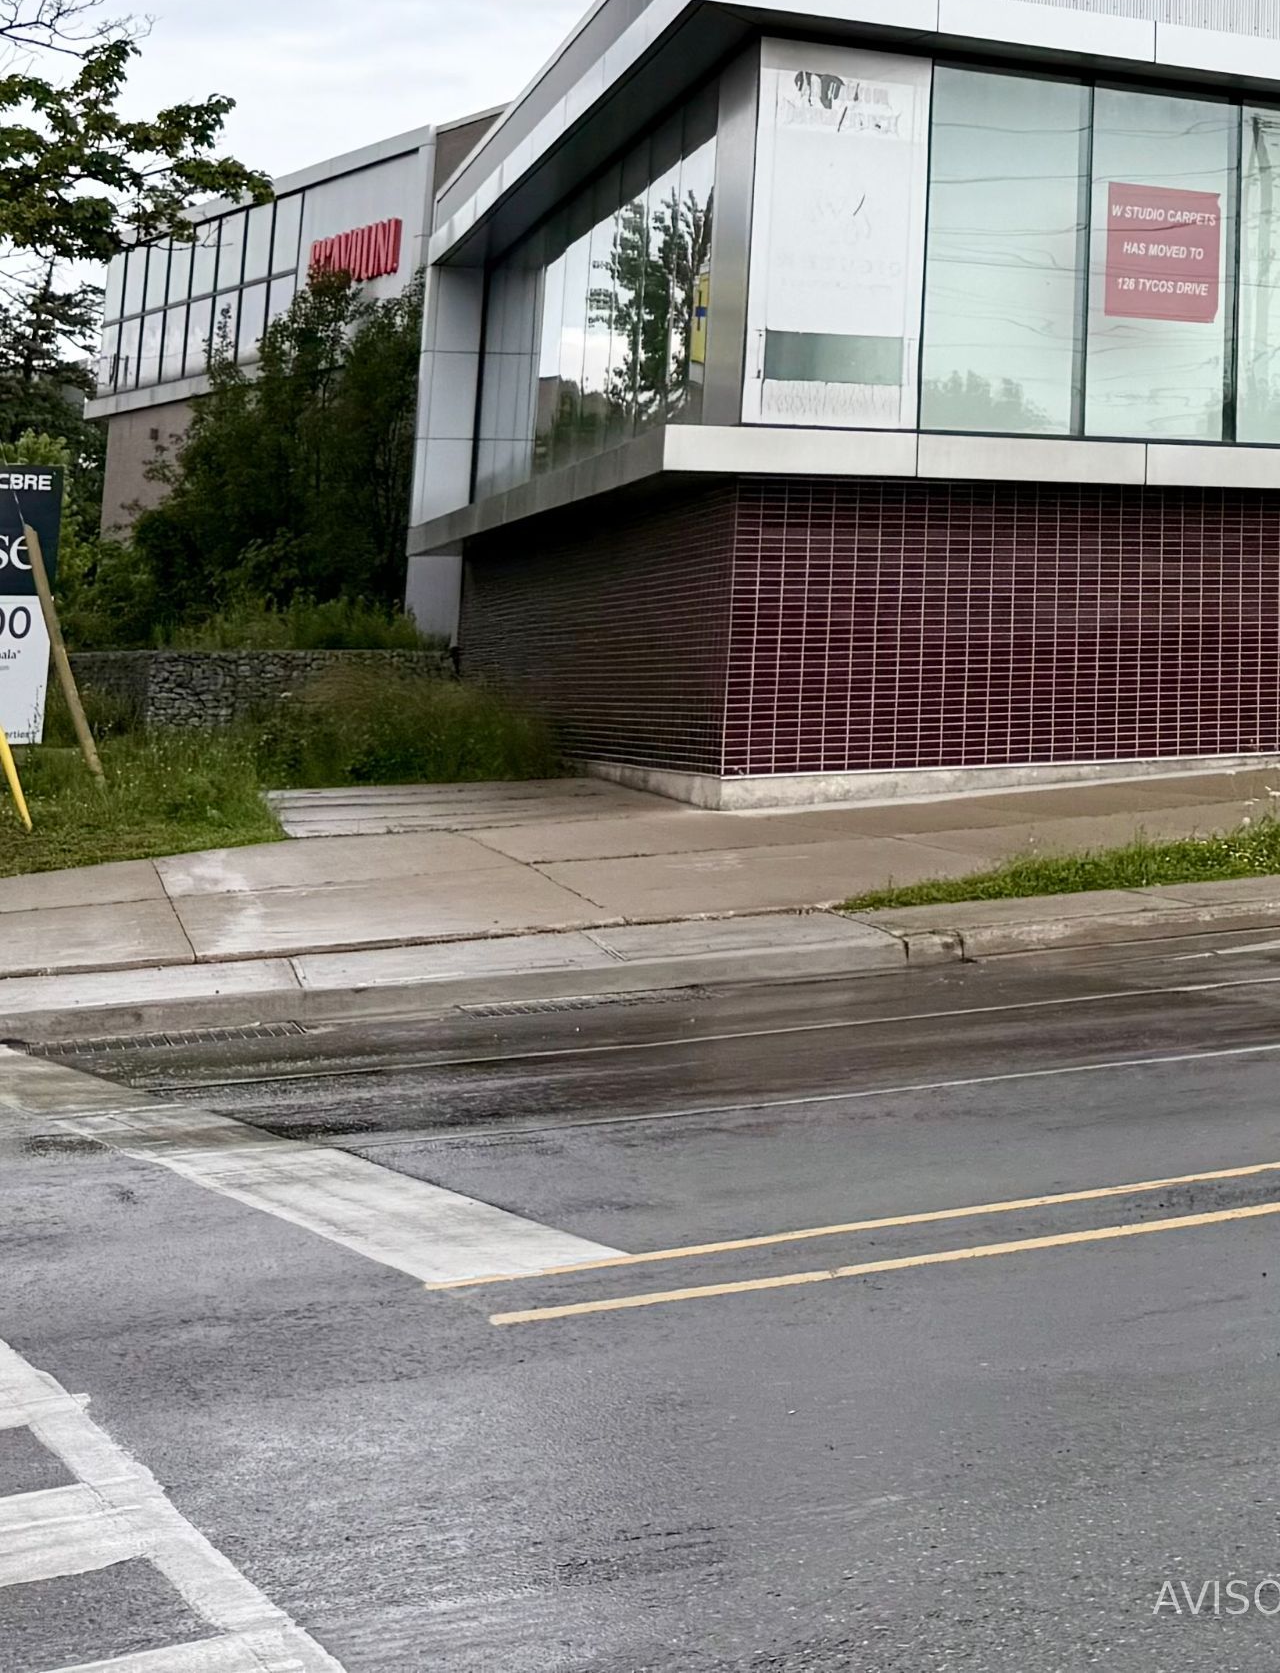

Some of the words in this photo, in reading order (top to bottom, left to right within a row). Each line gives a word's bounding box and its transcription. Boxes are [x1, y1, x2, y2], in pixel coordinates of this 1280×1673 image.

[1112, 205, 1123, 217] W
[1125, 206, 1164, 222] STUDIO
[1167, 210, 1216, 226] CARPETS
[1123, 242, 1146, 255] HAS
[1148, 244, 1187, 258] MOVED
[1189, 247, 1204, 259] TO
[1138, 278, 1174, 293] TYCOS
[1176, 282, 1209, 296] DRIVE
[0, 473, 52, 490] CBRE
